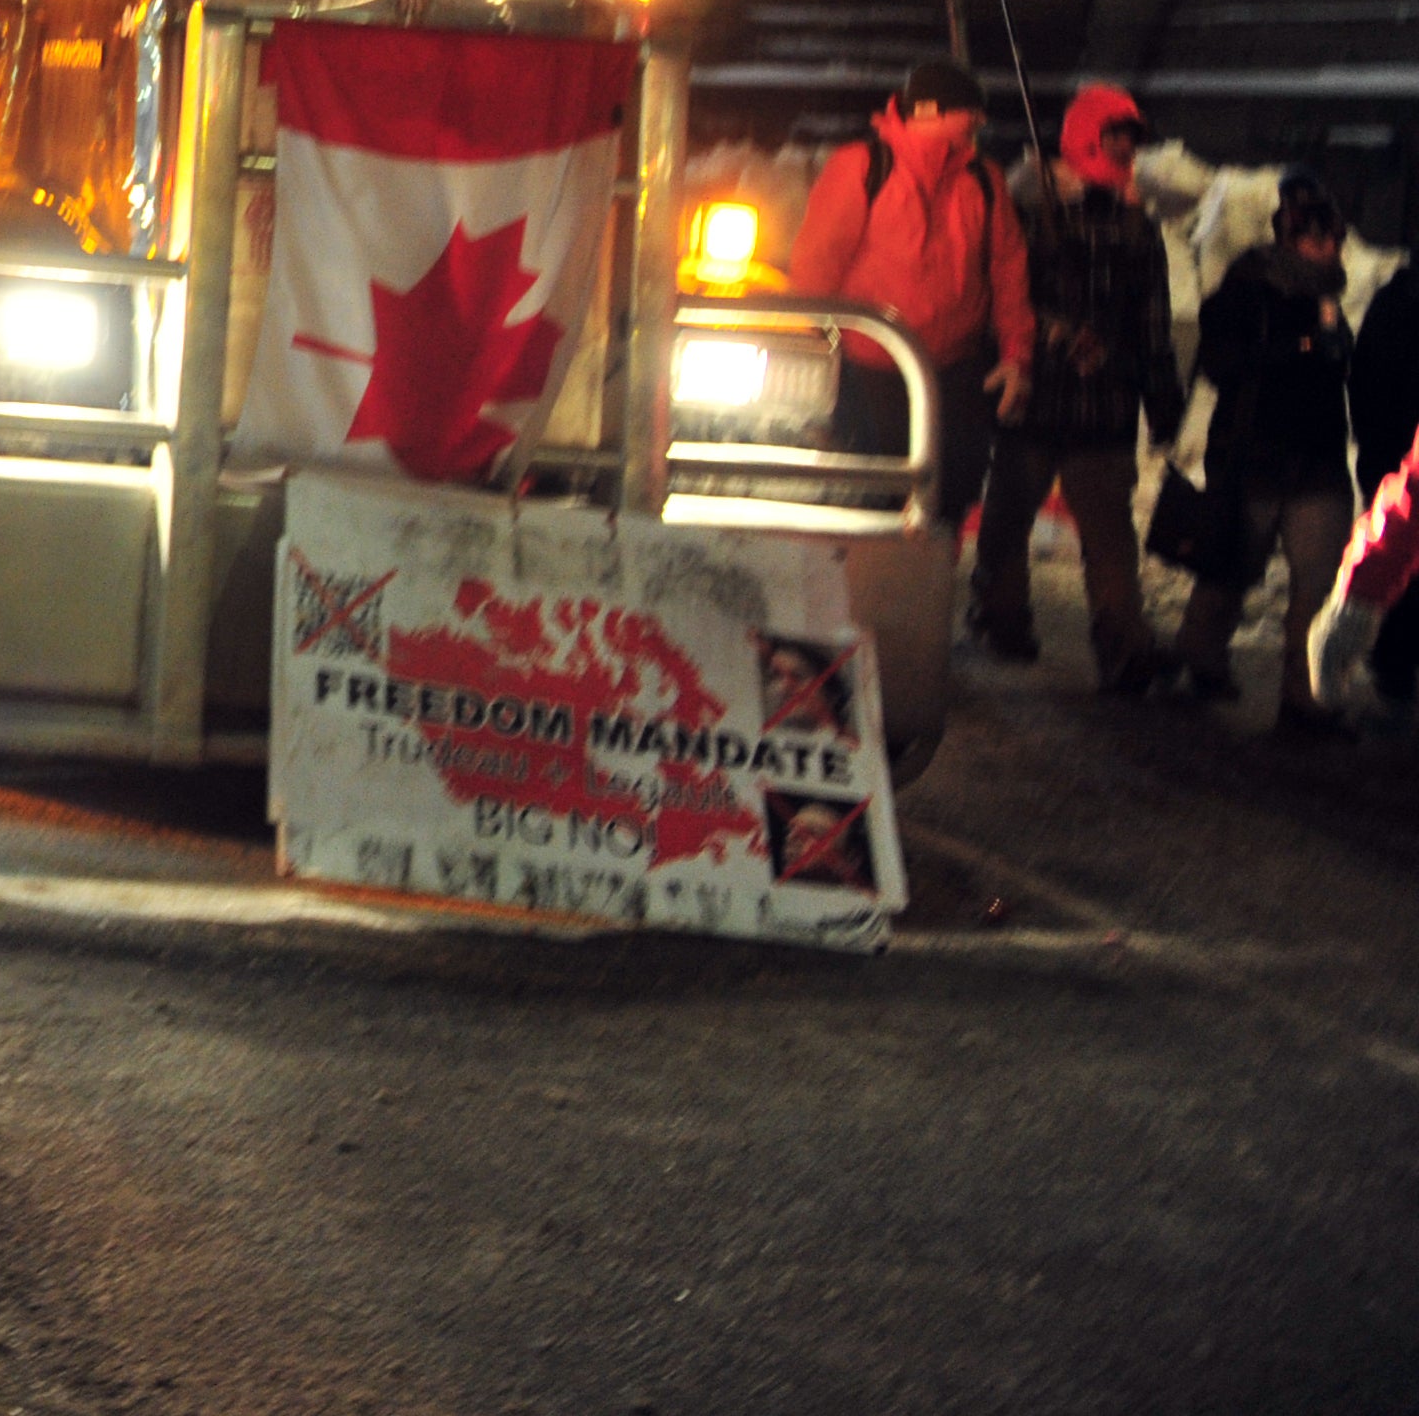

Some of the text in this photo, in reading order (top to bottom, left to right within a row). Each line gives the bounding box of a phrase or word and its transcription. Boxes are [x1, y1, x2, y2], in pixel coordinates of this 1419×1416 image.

[313, 669, 855, 785] FREEDOM MANDATE
[361, 721, 530, 781] Trudeau
[475, 794, 554, 847] BIG
